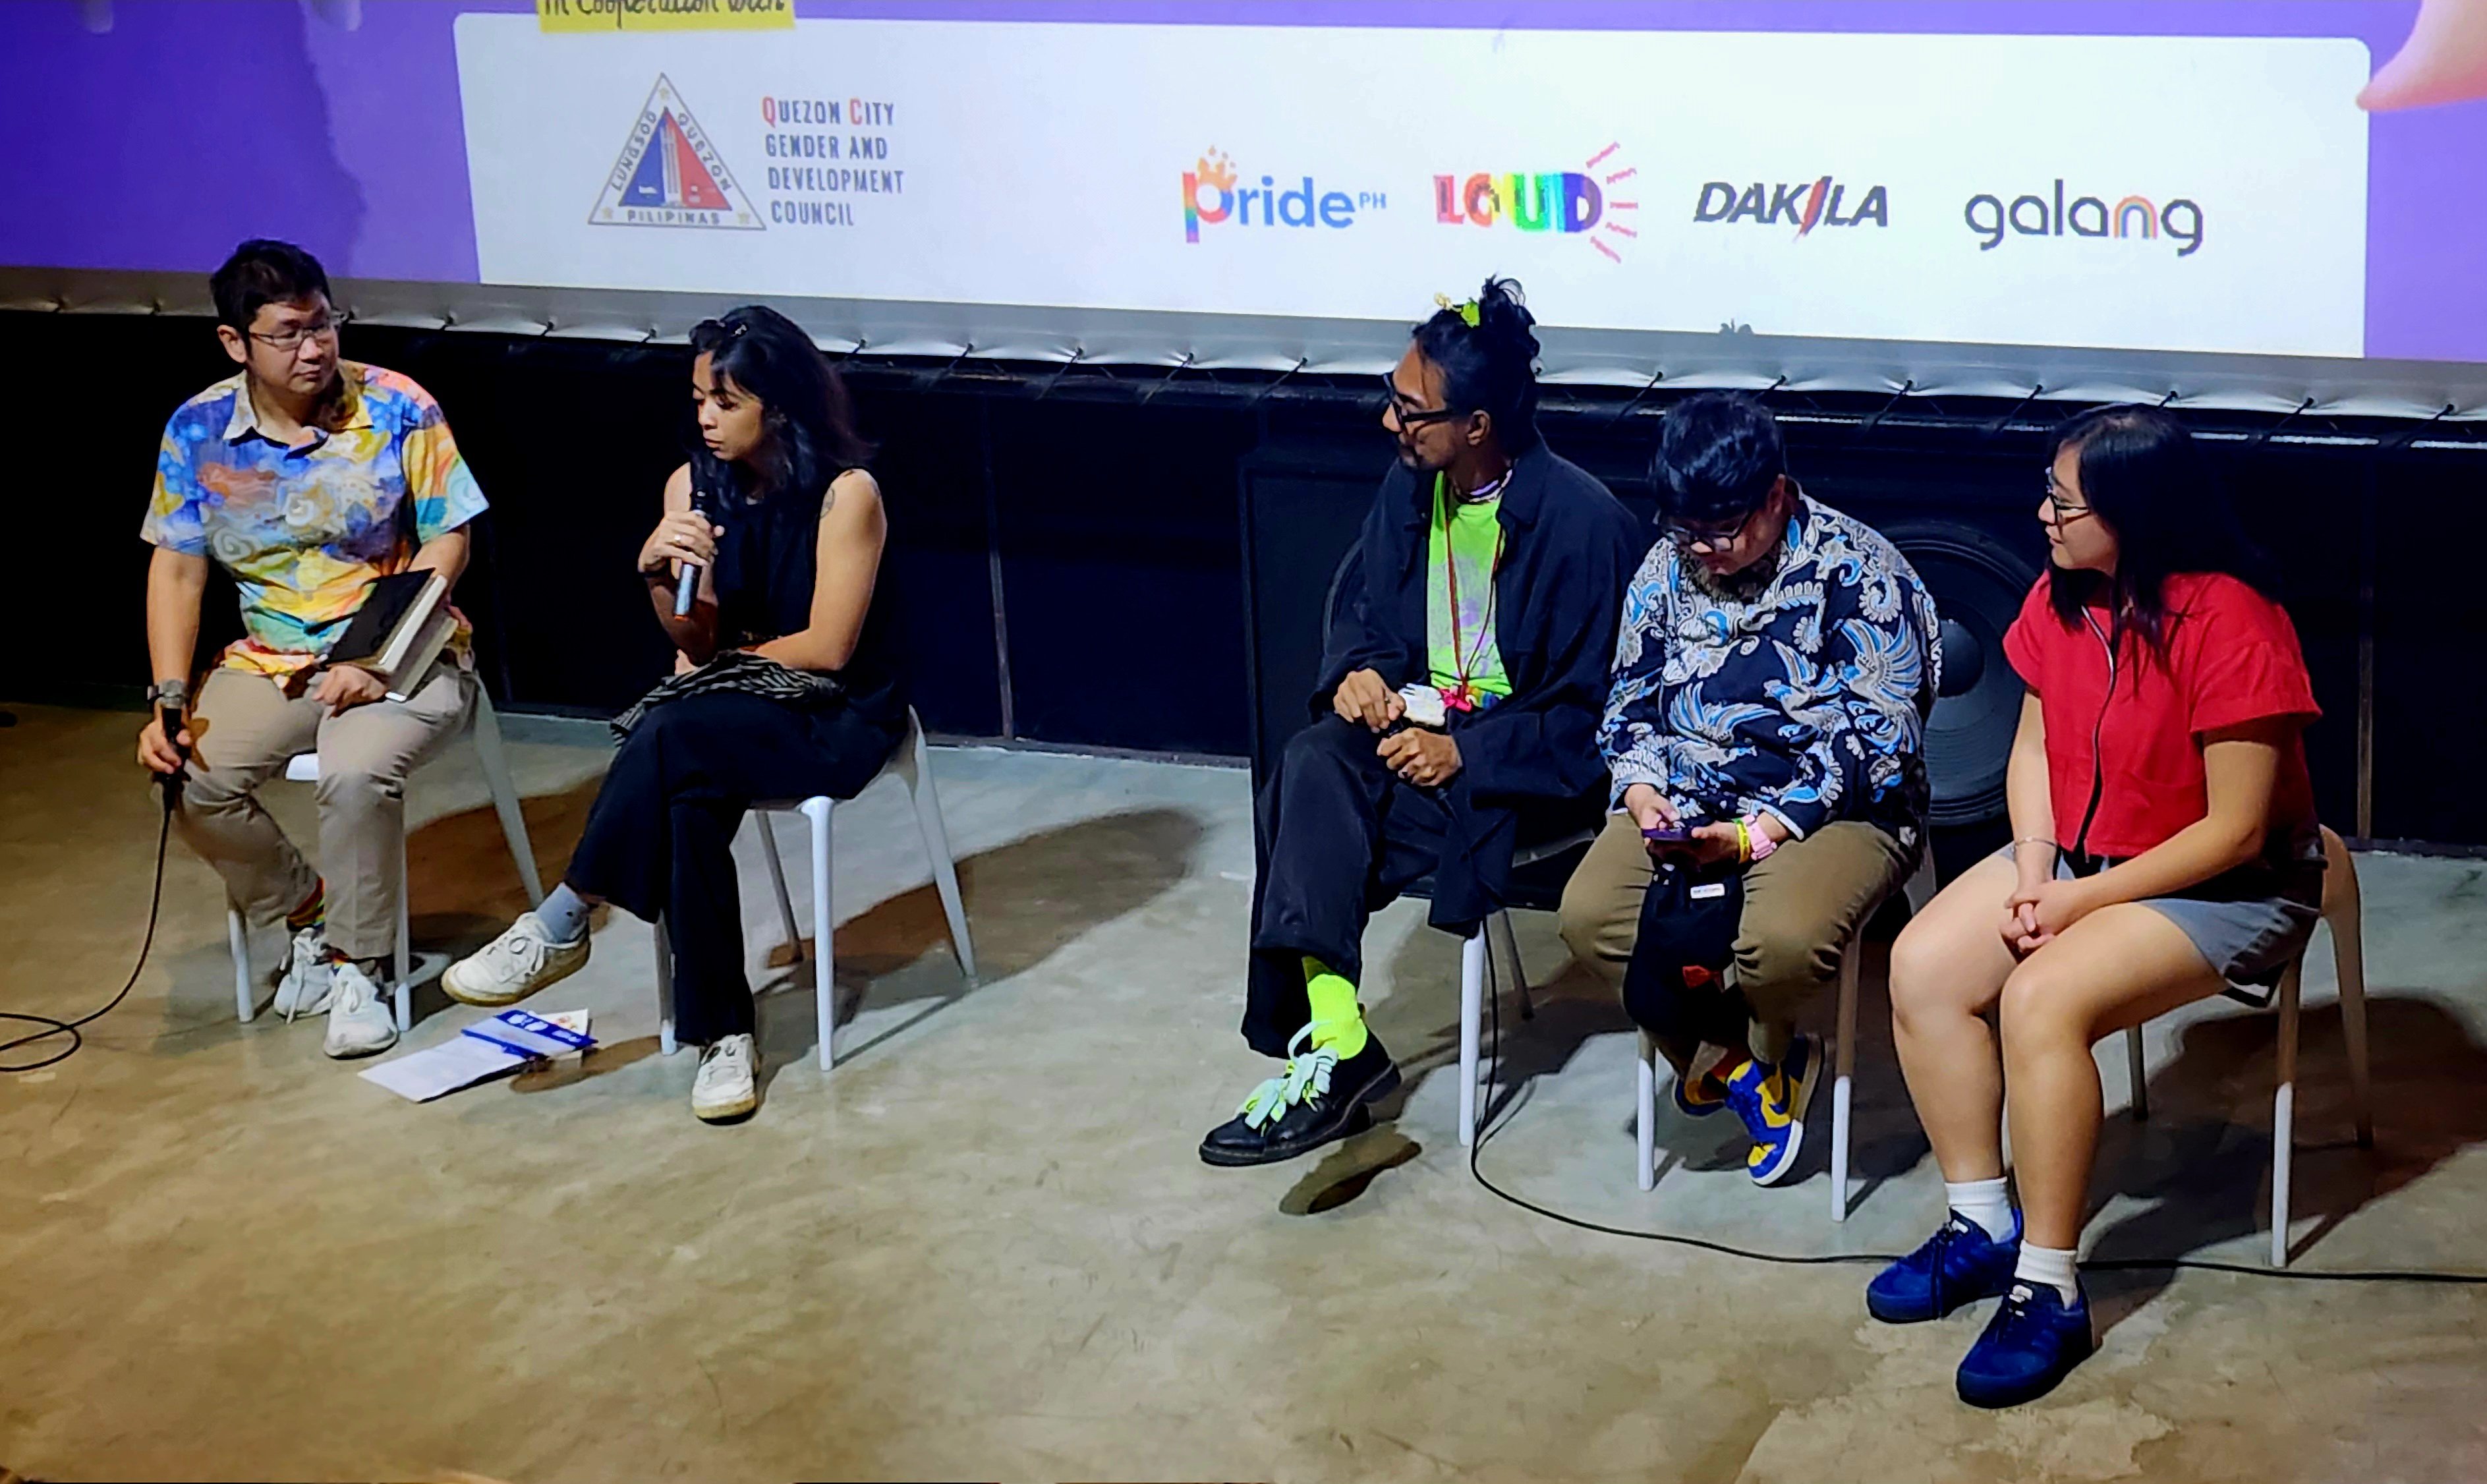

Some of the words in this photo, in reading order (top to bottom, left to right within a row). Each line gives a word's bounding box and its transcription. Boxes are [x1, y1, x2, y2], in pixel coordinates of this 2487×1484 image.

[762, 96, 841, 128] QUEZON
[849, 98, 894, 125] CITY
[765, 134, 840, 159] GENDER
[849, 136, 888, 160] AND
[768, 167, 905, 194] DEVELOPMENT
[771, 200, 854, 226] COUNCIL
[1433, 171, 1603, 233] LOUD
[627, 209, 720, 225] PILIPINAS
[1964, 179, 2203, 256] galang
